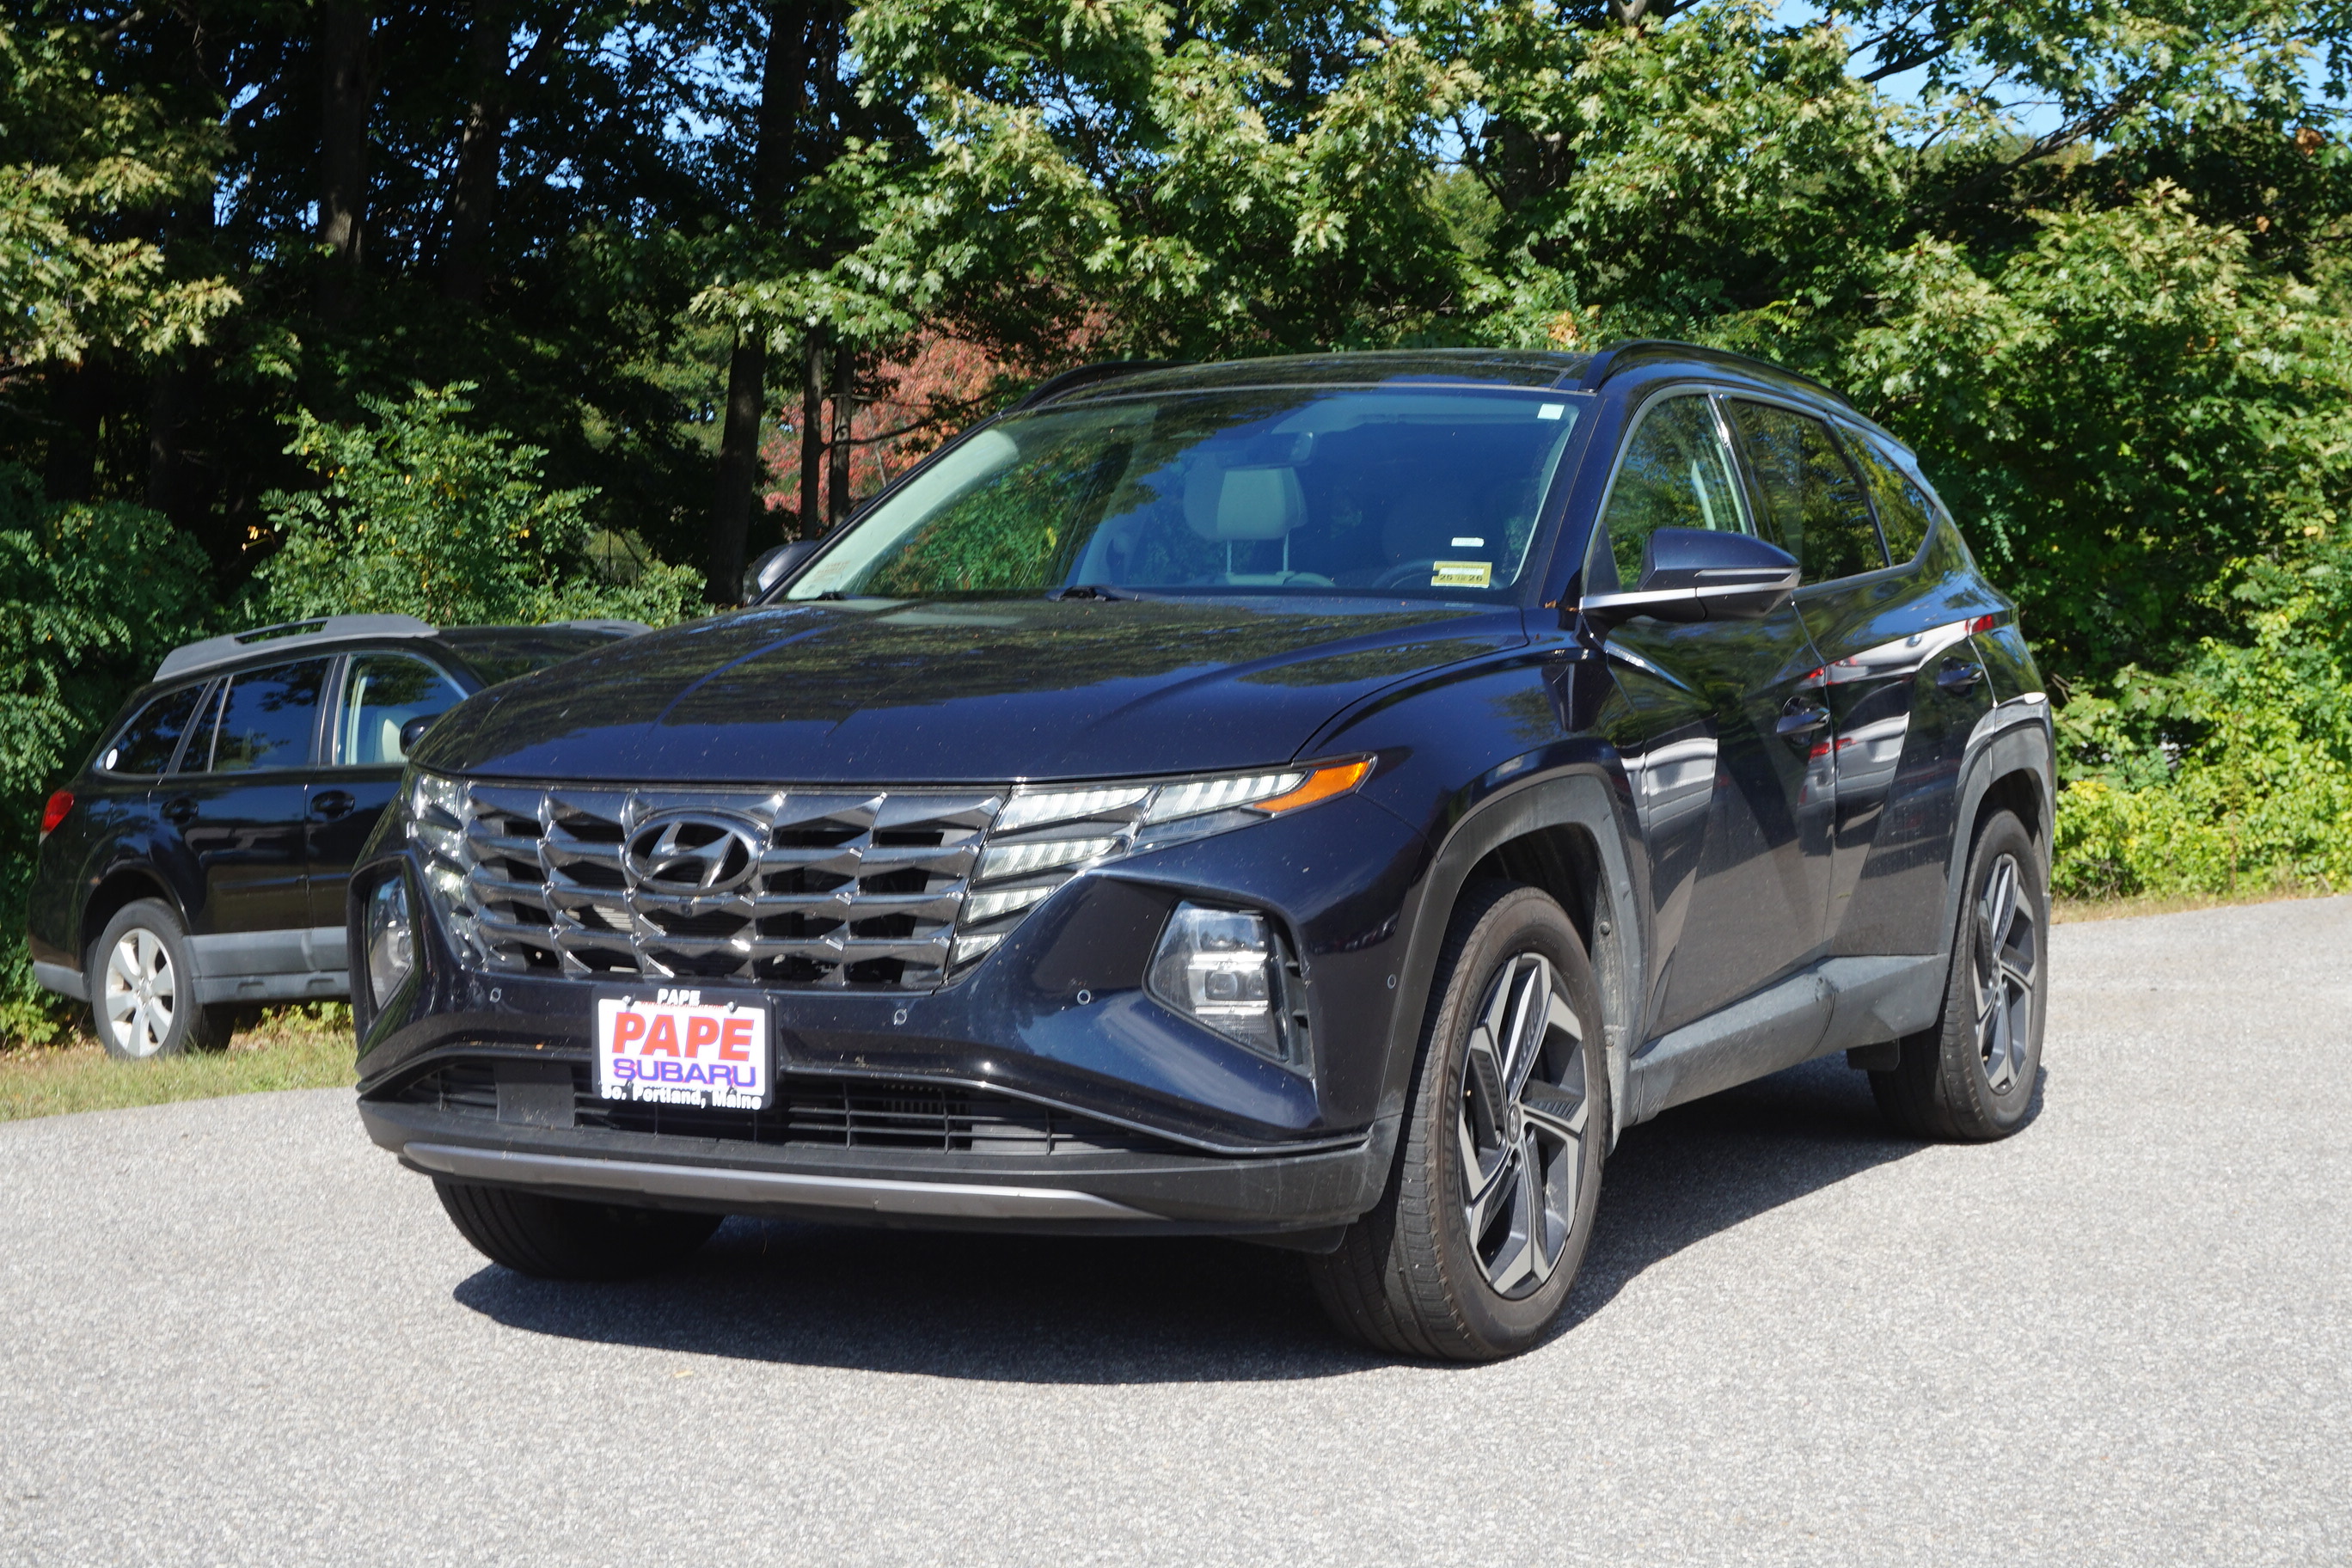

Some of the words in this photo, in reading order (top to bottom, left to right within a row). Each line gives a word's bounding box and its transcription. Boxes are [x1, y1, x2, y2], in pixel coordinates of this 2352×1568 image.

[657, 988, 701, 1006] PAPE
[611, 1011, 755, 1062] PAPE
[613, 1057, 756, 1088] SUBARU
[632, 1087, 707, 1109] Portland,
[712, 1089, 763, 1111] Maine
[1443, 1074, 1459, 1231] MICHELIN
